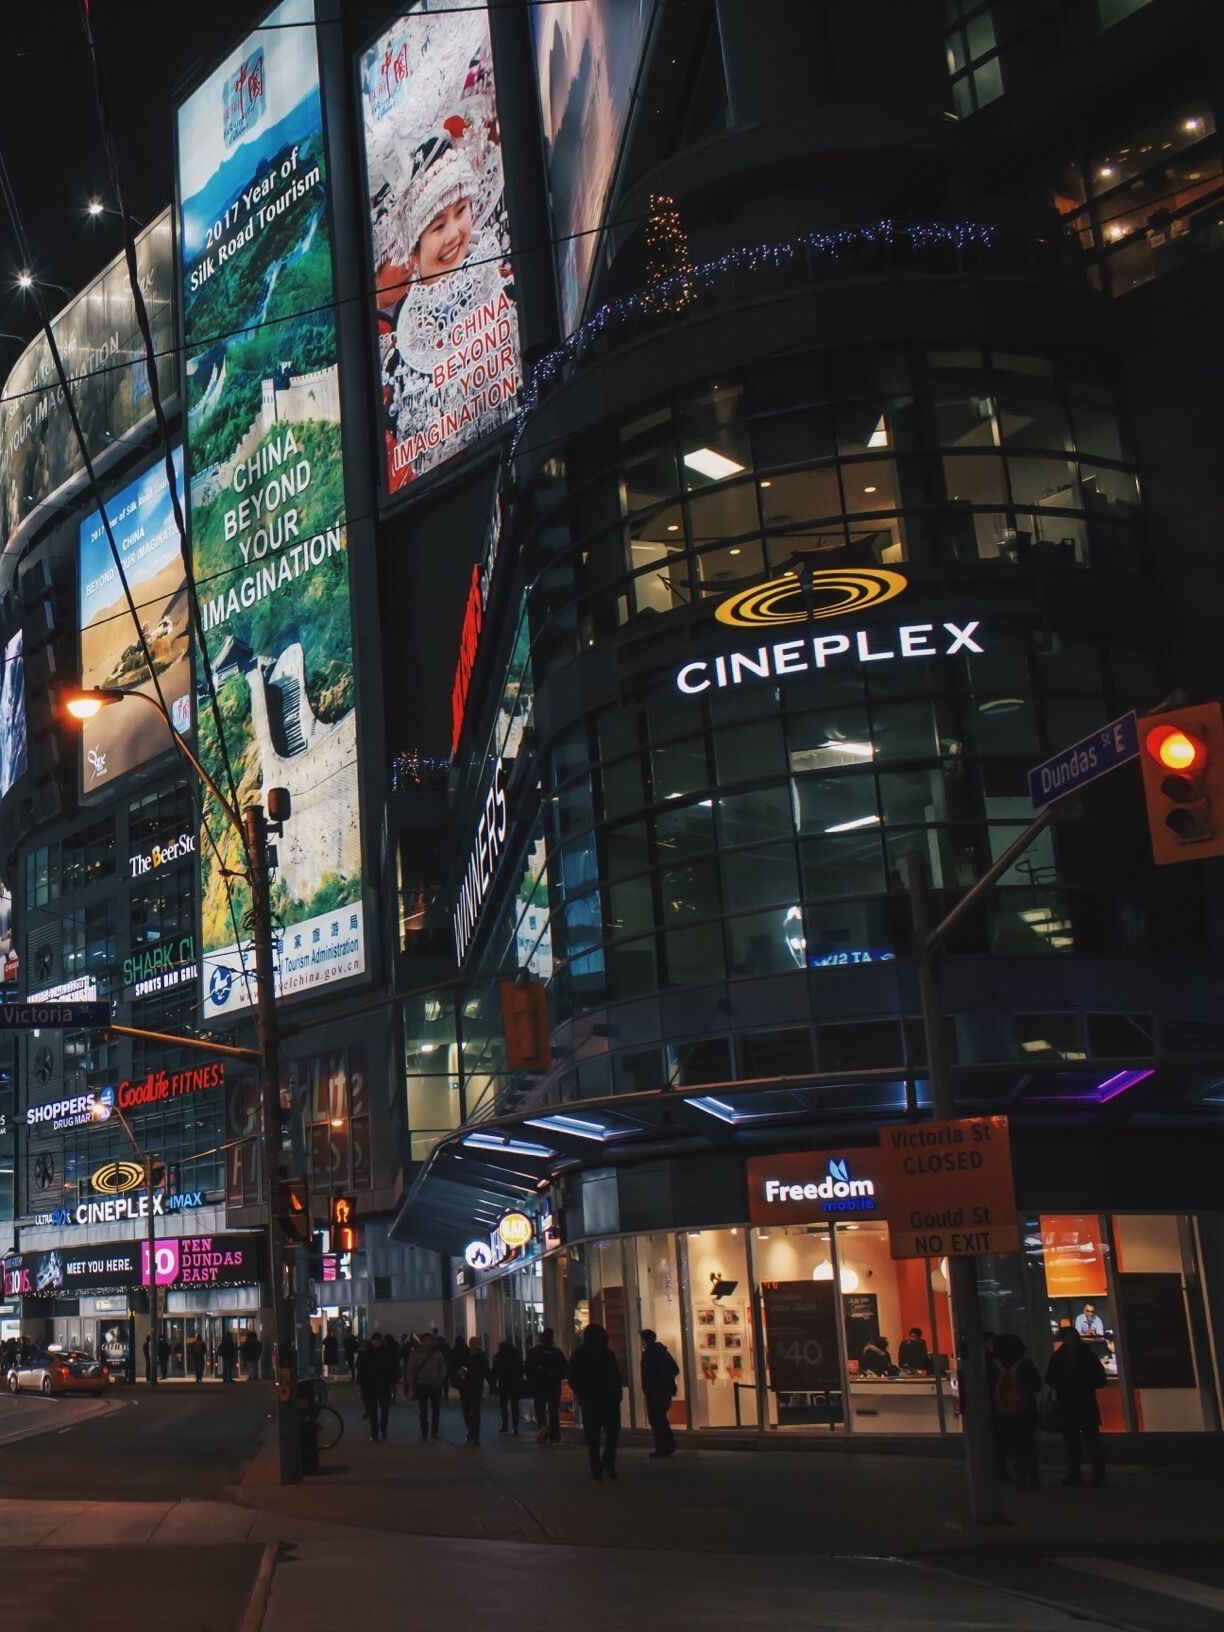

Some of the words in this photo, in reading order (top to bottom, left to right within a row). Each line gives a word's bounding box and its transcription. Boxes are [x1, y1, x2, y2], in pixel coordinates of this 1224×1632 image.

[206, 204, 240, 249] 2017
[242, 171, 277, 211] Year
[281, 146, 299, 178] of
[190, 257, 216, 291] Silk
[218, 217, 254, 267] Road
[257, 166, 320, 229] Tourism
[450, 290, 510, 347] CHINA
[433, 319, 511, 389] BEYOND
[460, 345, 514, 397] YOUR
[9, 413, 33, 456] YOUR
[393, 371, 517, 470] IMAGINATION
[233, 428, 299, 493] CHINA
[119, 507, 127, 521] of
[224, 459, 311, 541] BEYOND
[122, 527, 145, 551] CHINA
[239, 508, 299, 567] YOUR
[86, 568, 114, 597] BEYOND
[202, 521, 341, 632] IMAGINATION
[676, 620, 984, 694] CINEPLEX
[1041, 746, 1098, 794] Dundas
[1101, 732, 1111, 747] St
[1113, 724, 1125, 752] E
[129, 853, 152, 878] The
[152, 841, 179, 869] Beer
[453, 755, 507, 967] WINNERS
[123, 941, 174, 985] SHARK
[285, 953, 309, 974] Tourism
[311, 937, 359, 964] Administration
[135, 976, 162, 997] SPORTS
[164, 970, 178, 988] BAR
[3, 1004, 73, 1024] Victoria
[118, 1070, 170, 1108] GoodLife
[172, 1063, 225, 1097] FITNES
[27, 1092, 95, 1125] SHOPPERS
[53, 1117, 74, 1130] DRUG
[74, 1112, 95, 1125] MART
[890, 1126, 964, 1148] Victoria
[972, 1123, 992, 1142] St
[903, 1150, 983, 1175] CLOSED
[765, 1175, 875, 1202] Freedom
[823, 1197, 875, 1212] mobile
[76, 1193, 164, 1225] CINEPLEX
[169, 1192, 202, 1210] IMAX
[910, 1207, 964, 1229] Gould
[972, 1206, 992, 1225] St
[145, 1248, 175, 1275] 10
[182, 1238, 213, 1252] TEN
[181, 1251, 243, 1267] DUNDAS
[914, 1234, 943, 1255] NO
[951, 1232, 990, 1252] EXIT
[67, 1260, 86, 1275] MEET
[87, 1259, 105, 1274] YOU
[106, 1258, 133, 1273] HERE.
[182, 1267, 219, 1282] EAST
